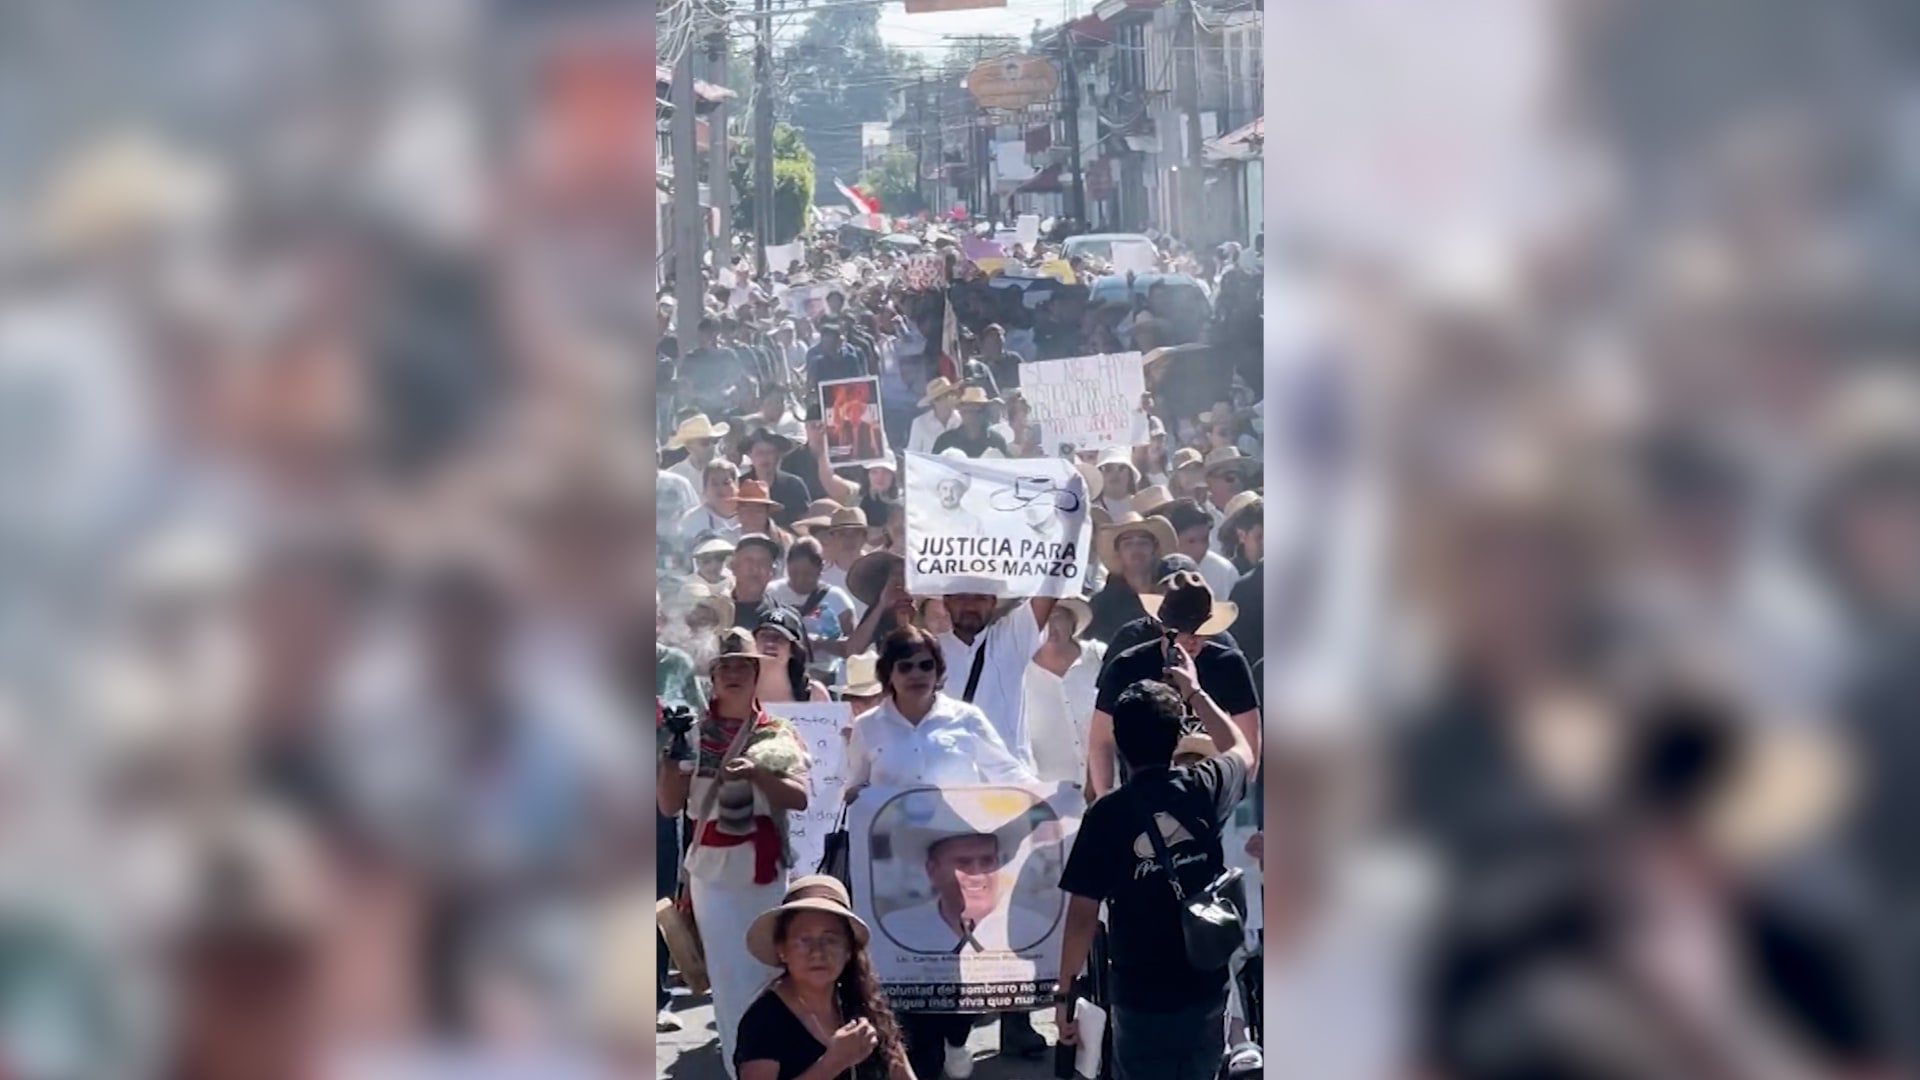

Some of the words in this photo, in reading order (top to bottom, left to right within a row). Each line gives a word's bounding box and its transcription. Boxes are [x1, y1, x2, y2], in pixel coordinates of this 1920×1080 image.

[917, 537, 1013, 557] JUSTICIA
[1020, 540, 1077, 561] PARA
[916, 558, 997, 575] CARLOS
[1002, 559, 1078, 579] MANZO
[960, 983, 1017, 995] sombrero
[1020, 982, 1036, 992] no
[958, 996, 984, 1007] viva
[987, 996, 1012, 1008] que
